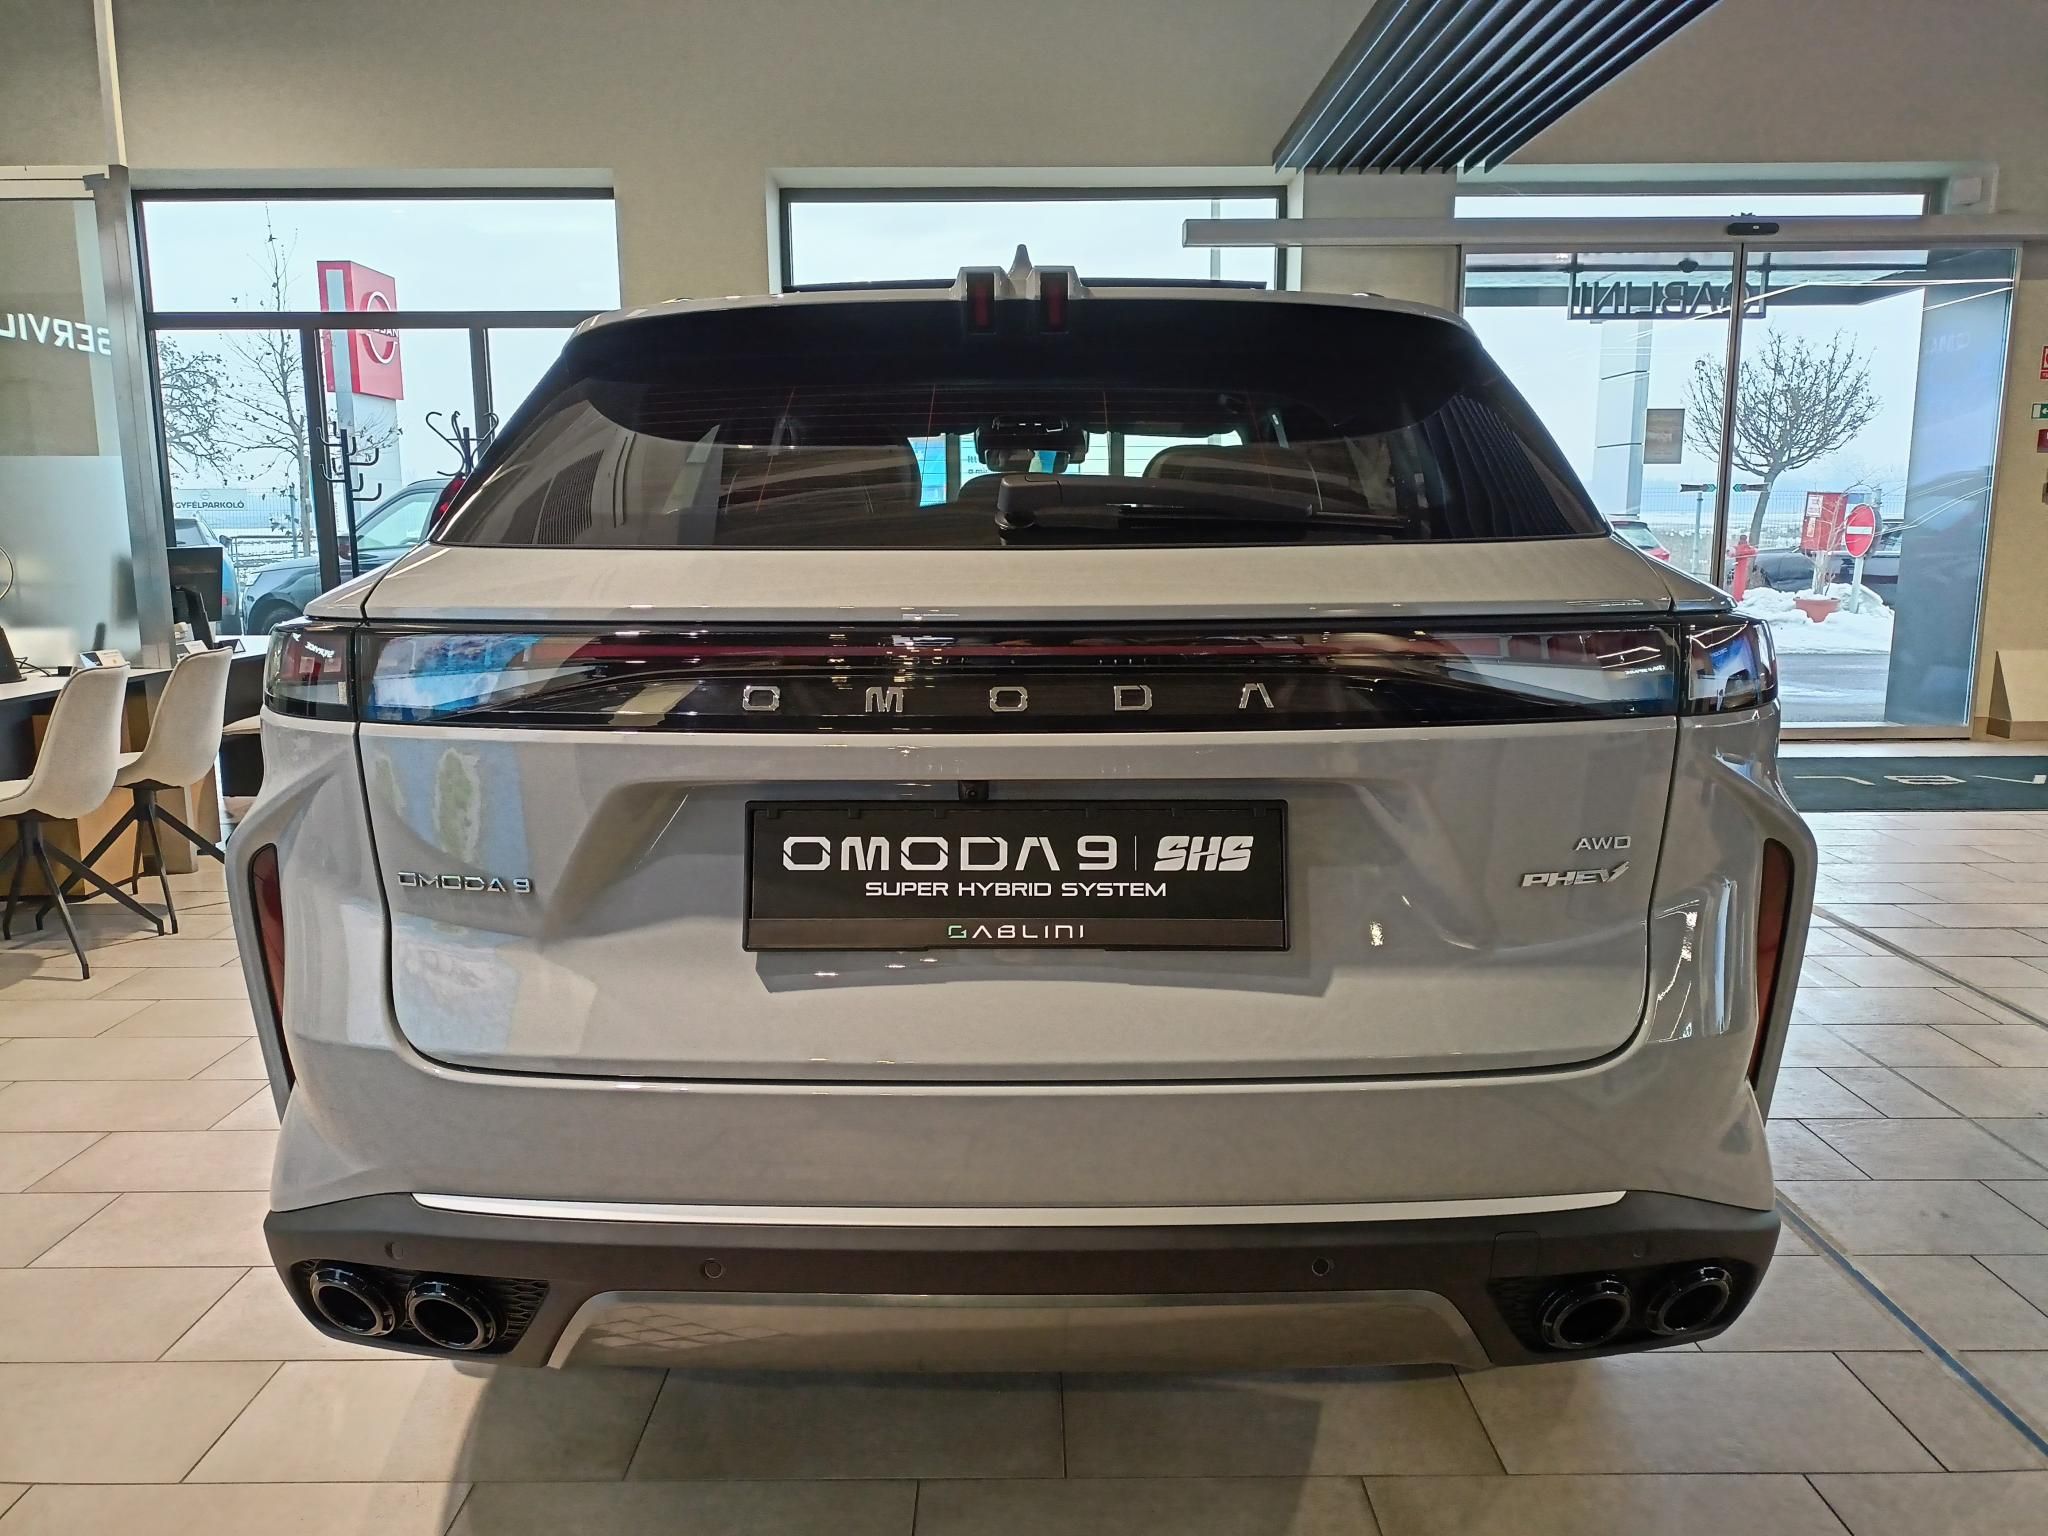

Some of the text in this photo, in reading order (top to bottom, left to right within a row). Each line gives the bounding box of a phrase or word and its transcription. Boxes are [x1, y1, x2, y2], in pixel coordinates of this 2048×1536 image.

[174, 499, 245, 509] GYFÉLPARKOLÓ
[742, 682, 1275, 713] OMODA
[1575, 835, 1631, 851] AWD
[783, 835, 1254, 871] OMODA 9 SHS
[398, 872, 530, 893] OMODA 9
[1521, 861, 1630, 888] PHEV
[865, 881, 1167, 897] SUPER HYBRID SYSTEM
[948, 925, 1085, 939] GABLINI
